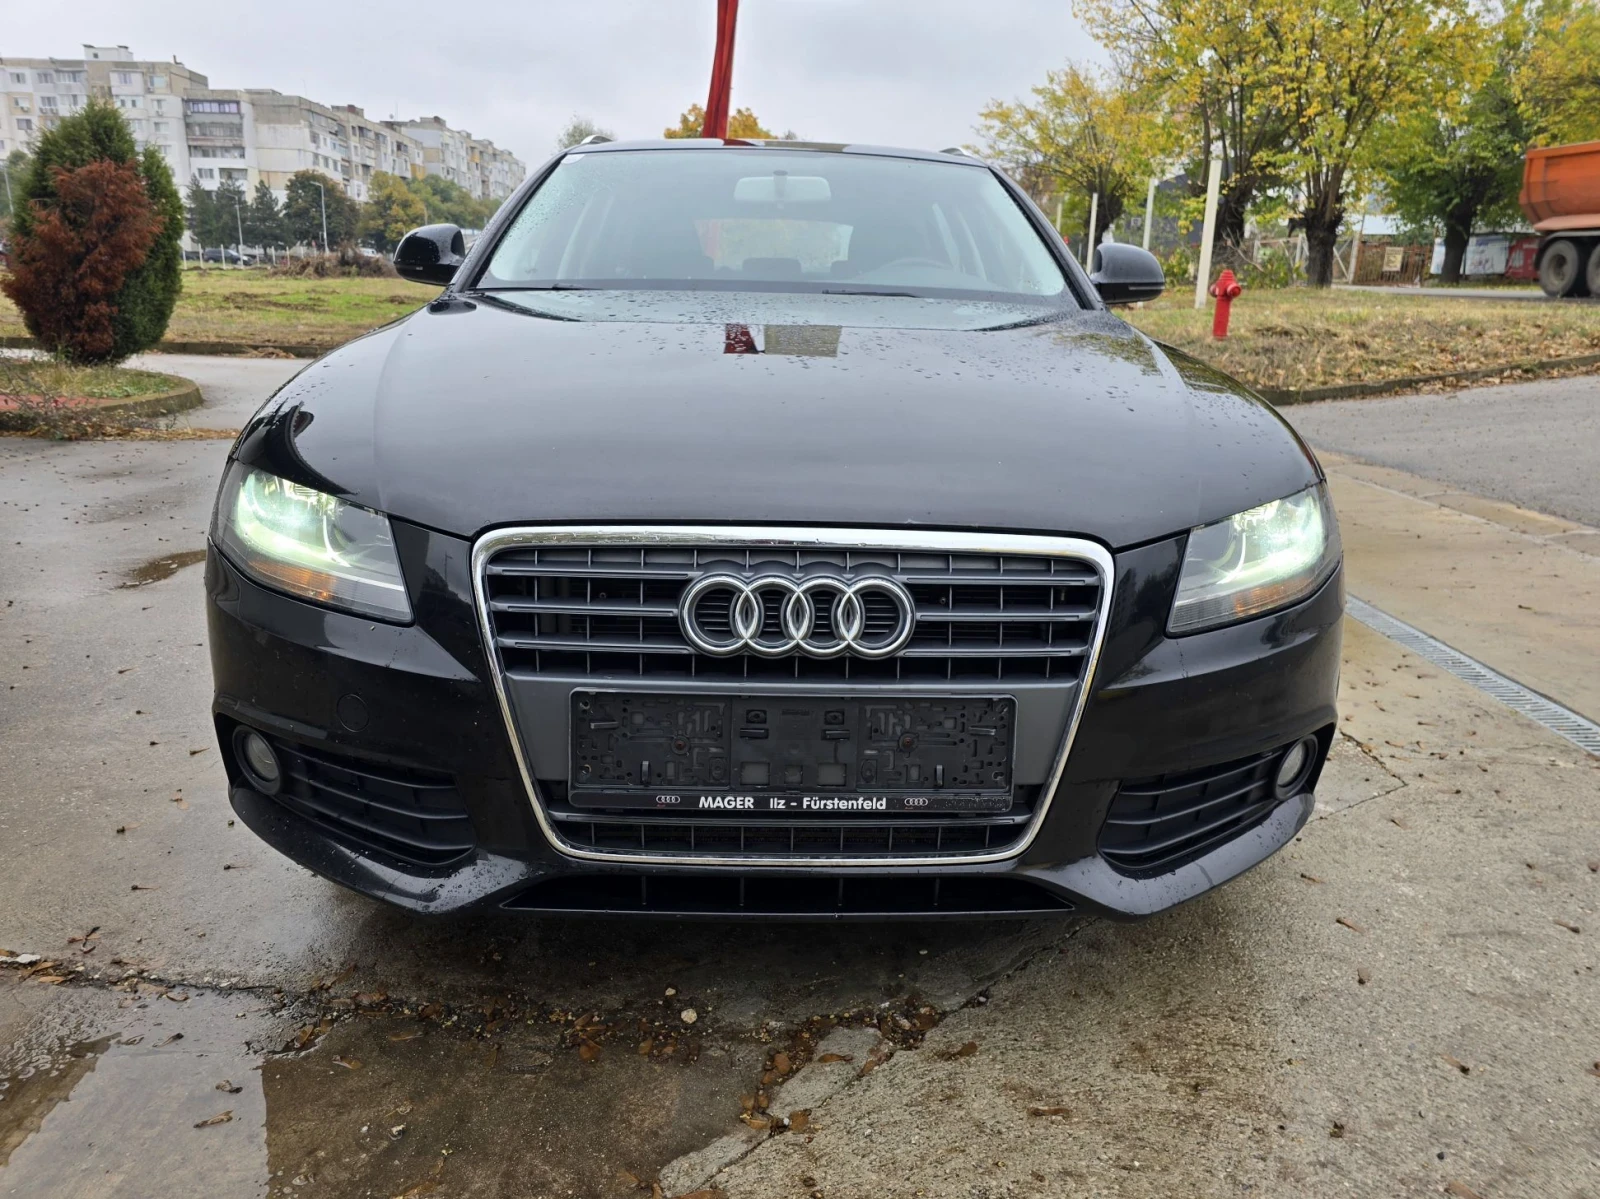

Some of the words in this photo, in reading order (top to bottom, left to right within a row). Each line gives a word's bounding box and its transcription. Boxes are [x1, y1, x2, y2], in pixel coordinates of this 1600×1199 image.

[699, 796, 754, 809] MAGER
[769, 797, 786, 809] Ilz
[802, 797, 887, 810] Fürstenfeld
